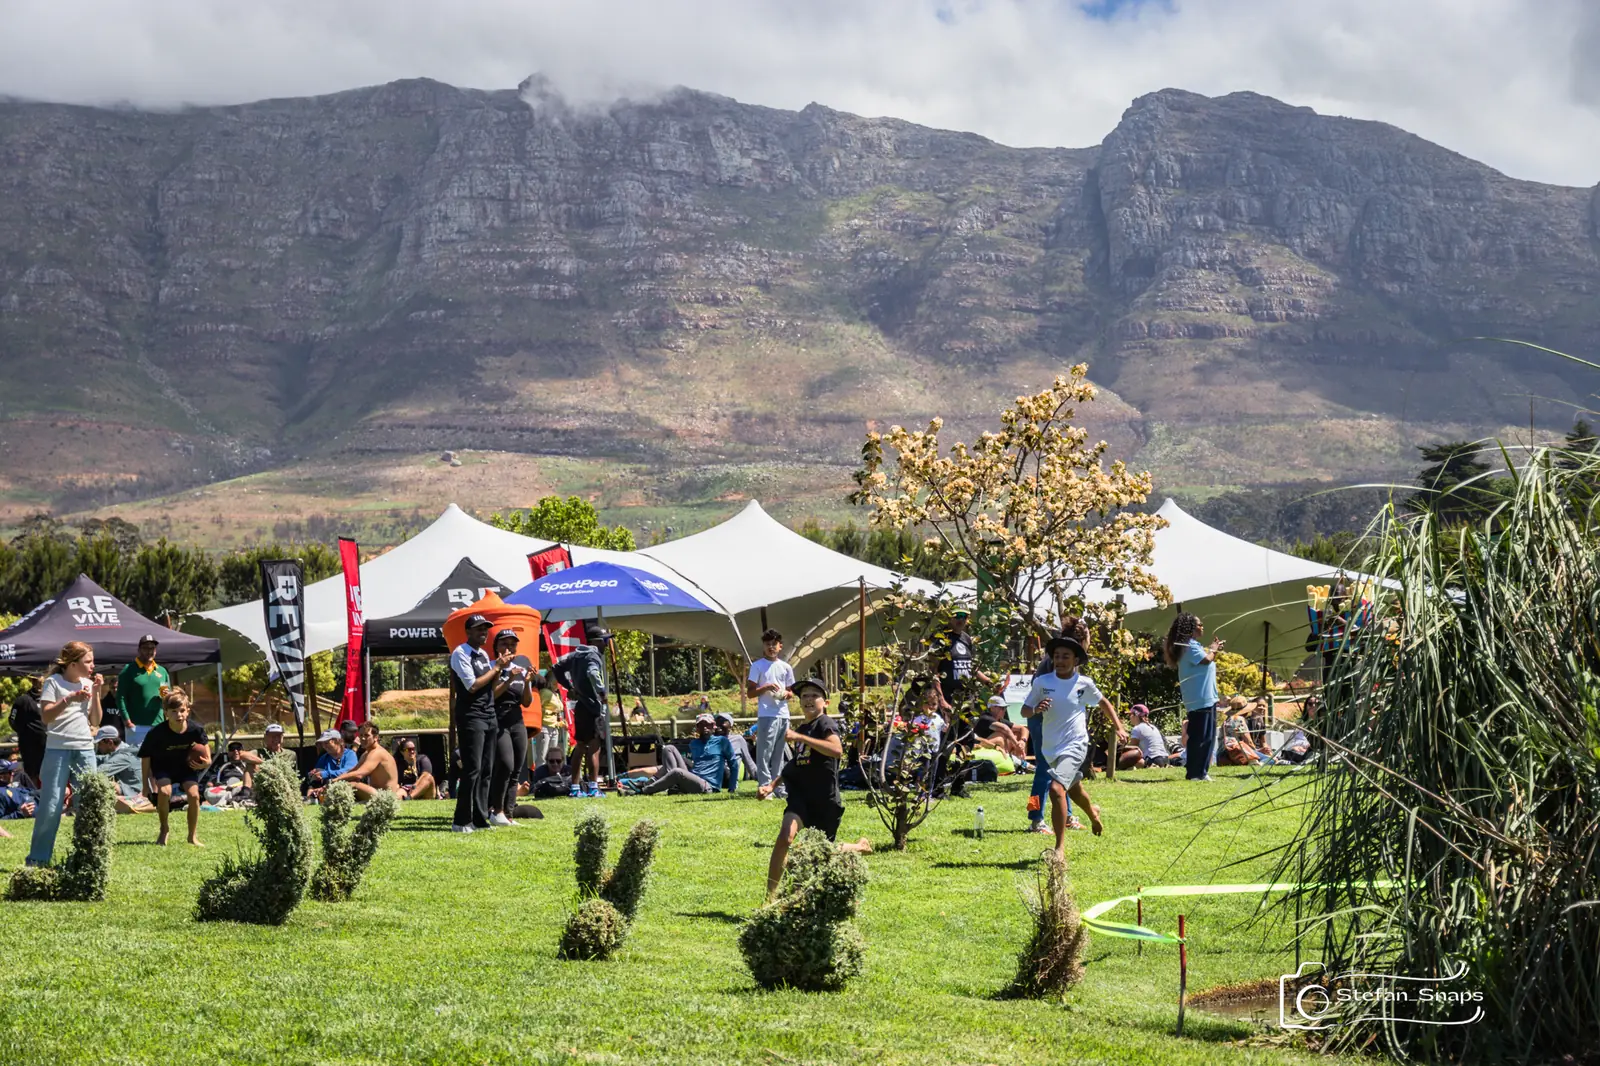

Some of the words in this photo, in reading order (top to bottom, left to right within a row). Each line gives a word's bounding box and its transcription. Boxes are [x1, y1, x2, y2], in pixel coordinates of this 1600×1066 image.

[538, 579, 618, 593] SportPesa
[67, 595, 117, 613] RE
[72, 613, 120, 623] VIVE
[389, 628, 437, 639] POWER
